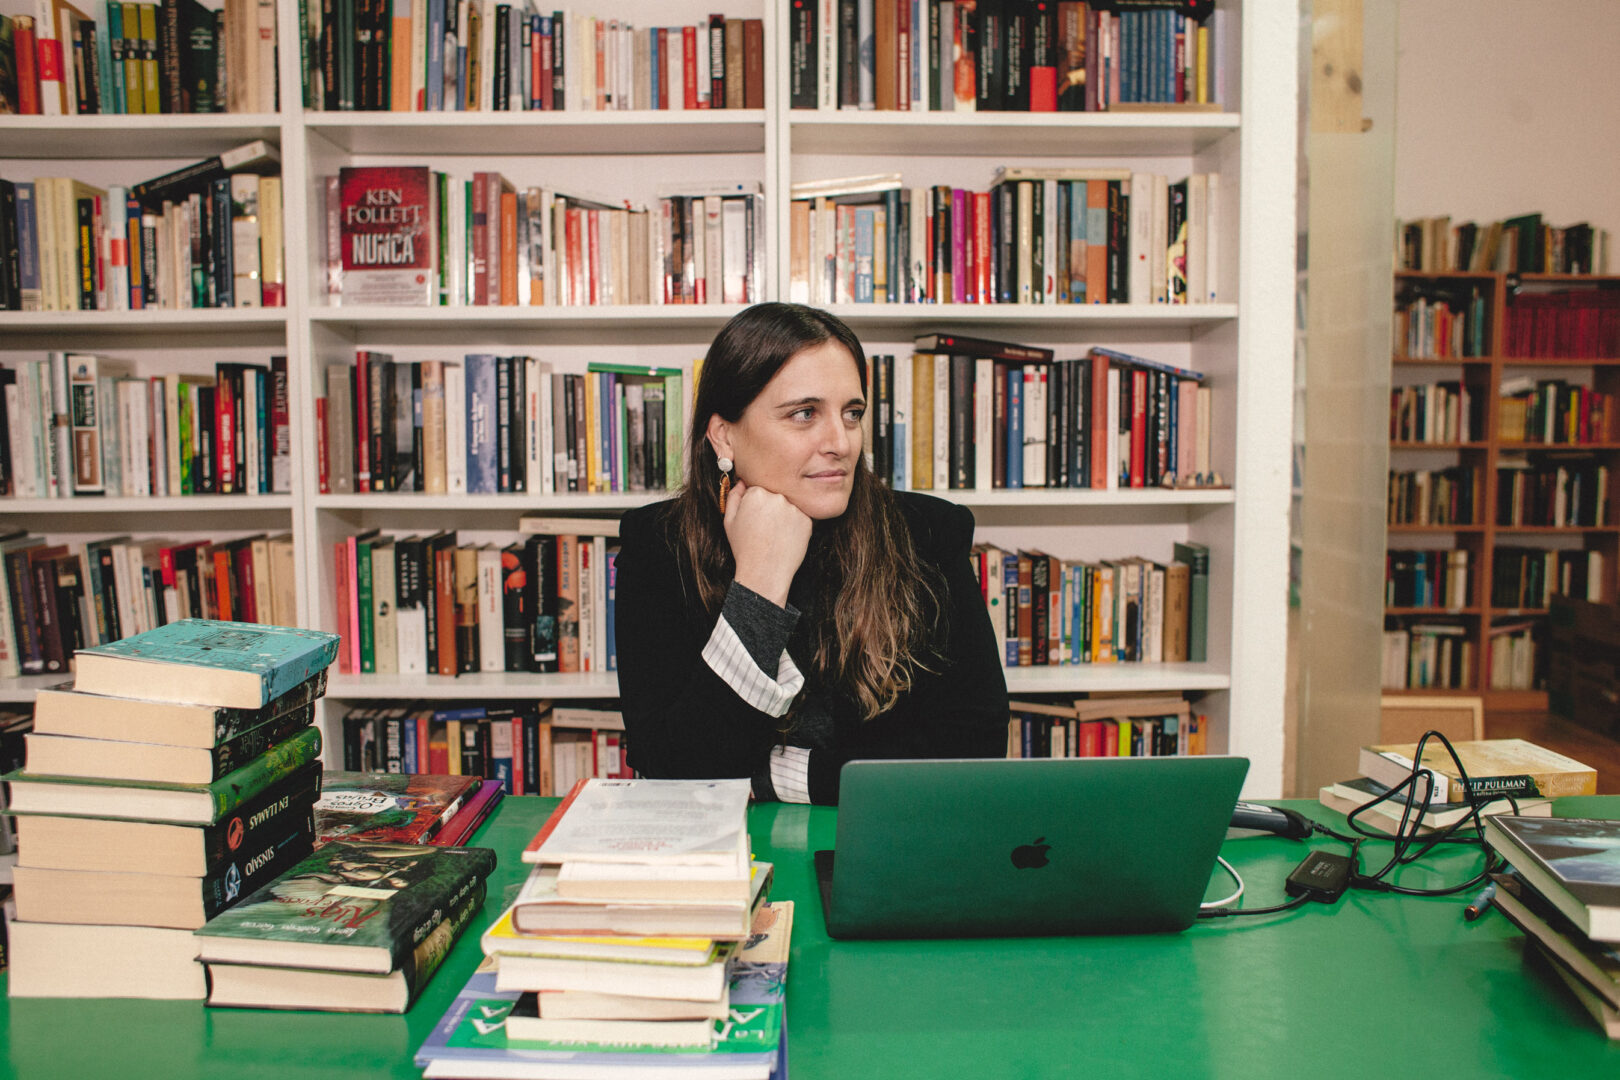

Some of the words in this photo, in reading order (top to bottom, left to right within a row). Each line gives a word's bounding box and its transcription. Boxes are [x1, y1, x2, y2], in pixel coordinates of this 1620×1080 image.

[711, 27, 723, 78] MINDHUNTER
[366, 189, 402, 204] KEN
[346, 204, 424, 225] FOLLETT
[352, 232, 415, 265] NUNCA
[386, 720, 401, 759] FUTURE
[1484, 778, 1527, 789] PULLMAN
[279, 795, 289, 809] EN
[330, 801, 373, 810] Ogros
[248, 801, 278, 830] LLAMAS
[244, 845, 275, 877] SINSAJO
